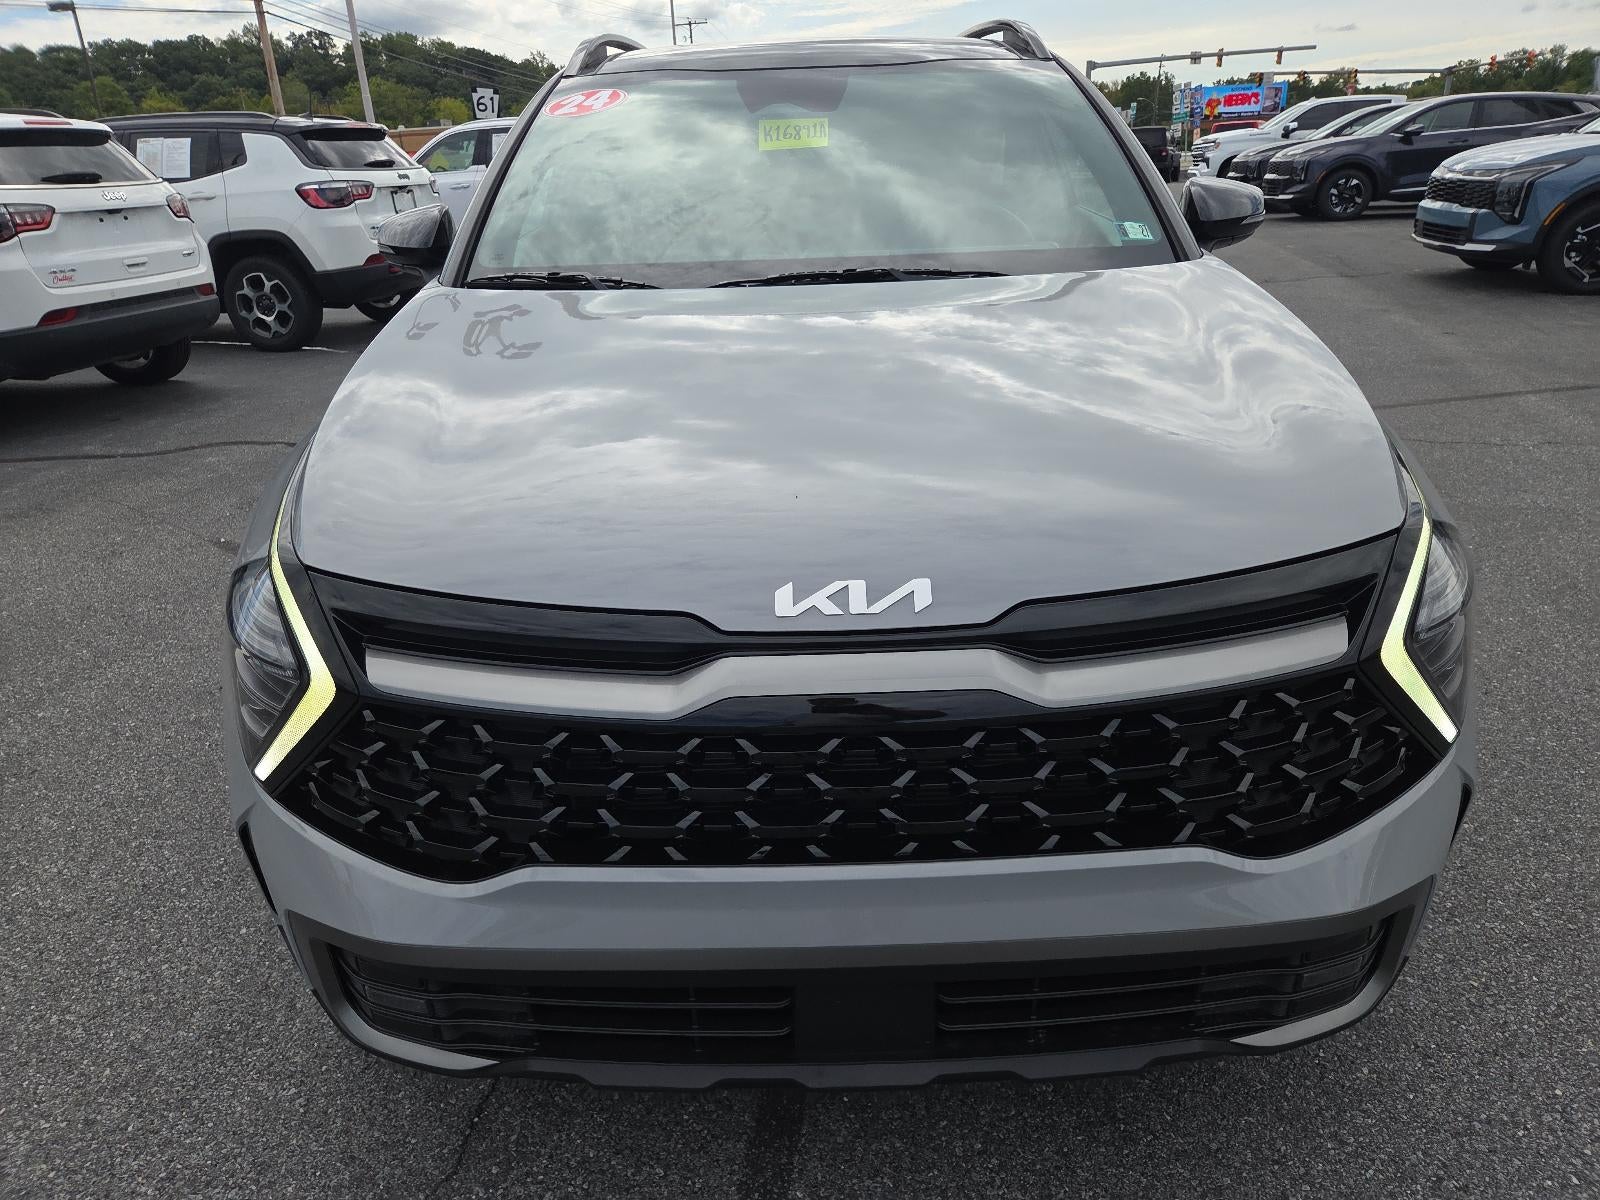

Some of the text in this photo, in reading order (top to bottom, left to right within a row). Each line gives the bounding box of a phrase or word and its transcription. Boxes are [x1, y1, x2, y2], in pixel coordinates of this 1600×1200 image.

[476, 95, 495, 113] 61
[552, 90, 613, 115] 24
[101, 190, 128, 202] Jeep
[774, 578, 933, 618] KIA
